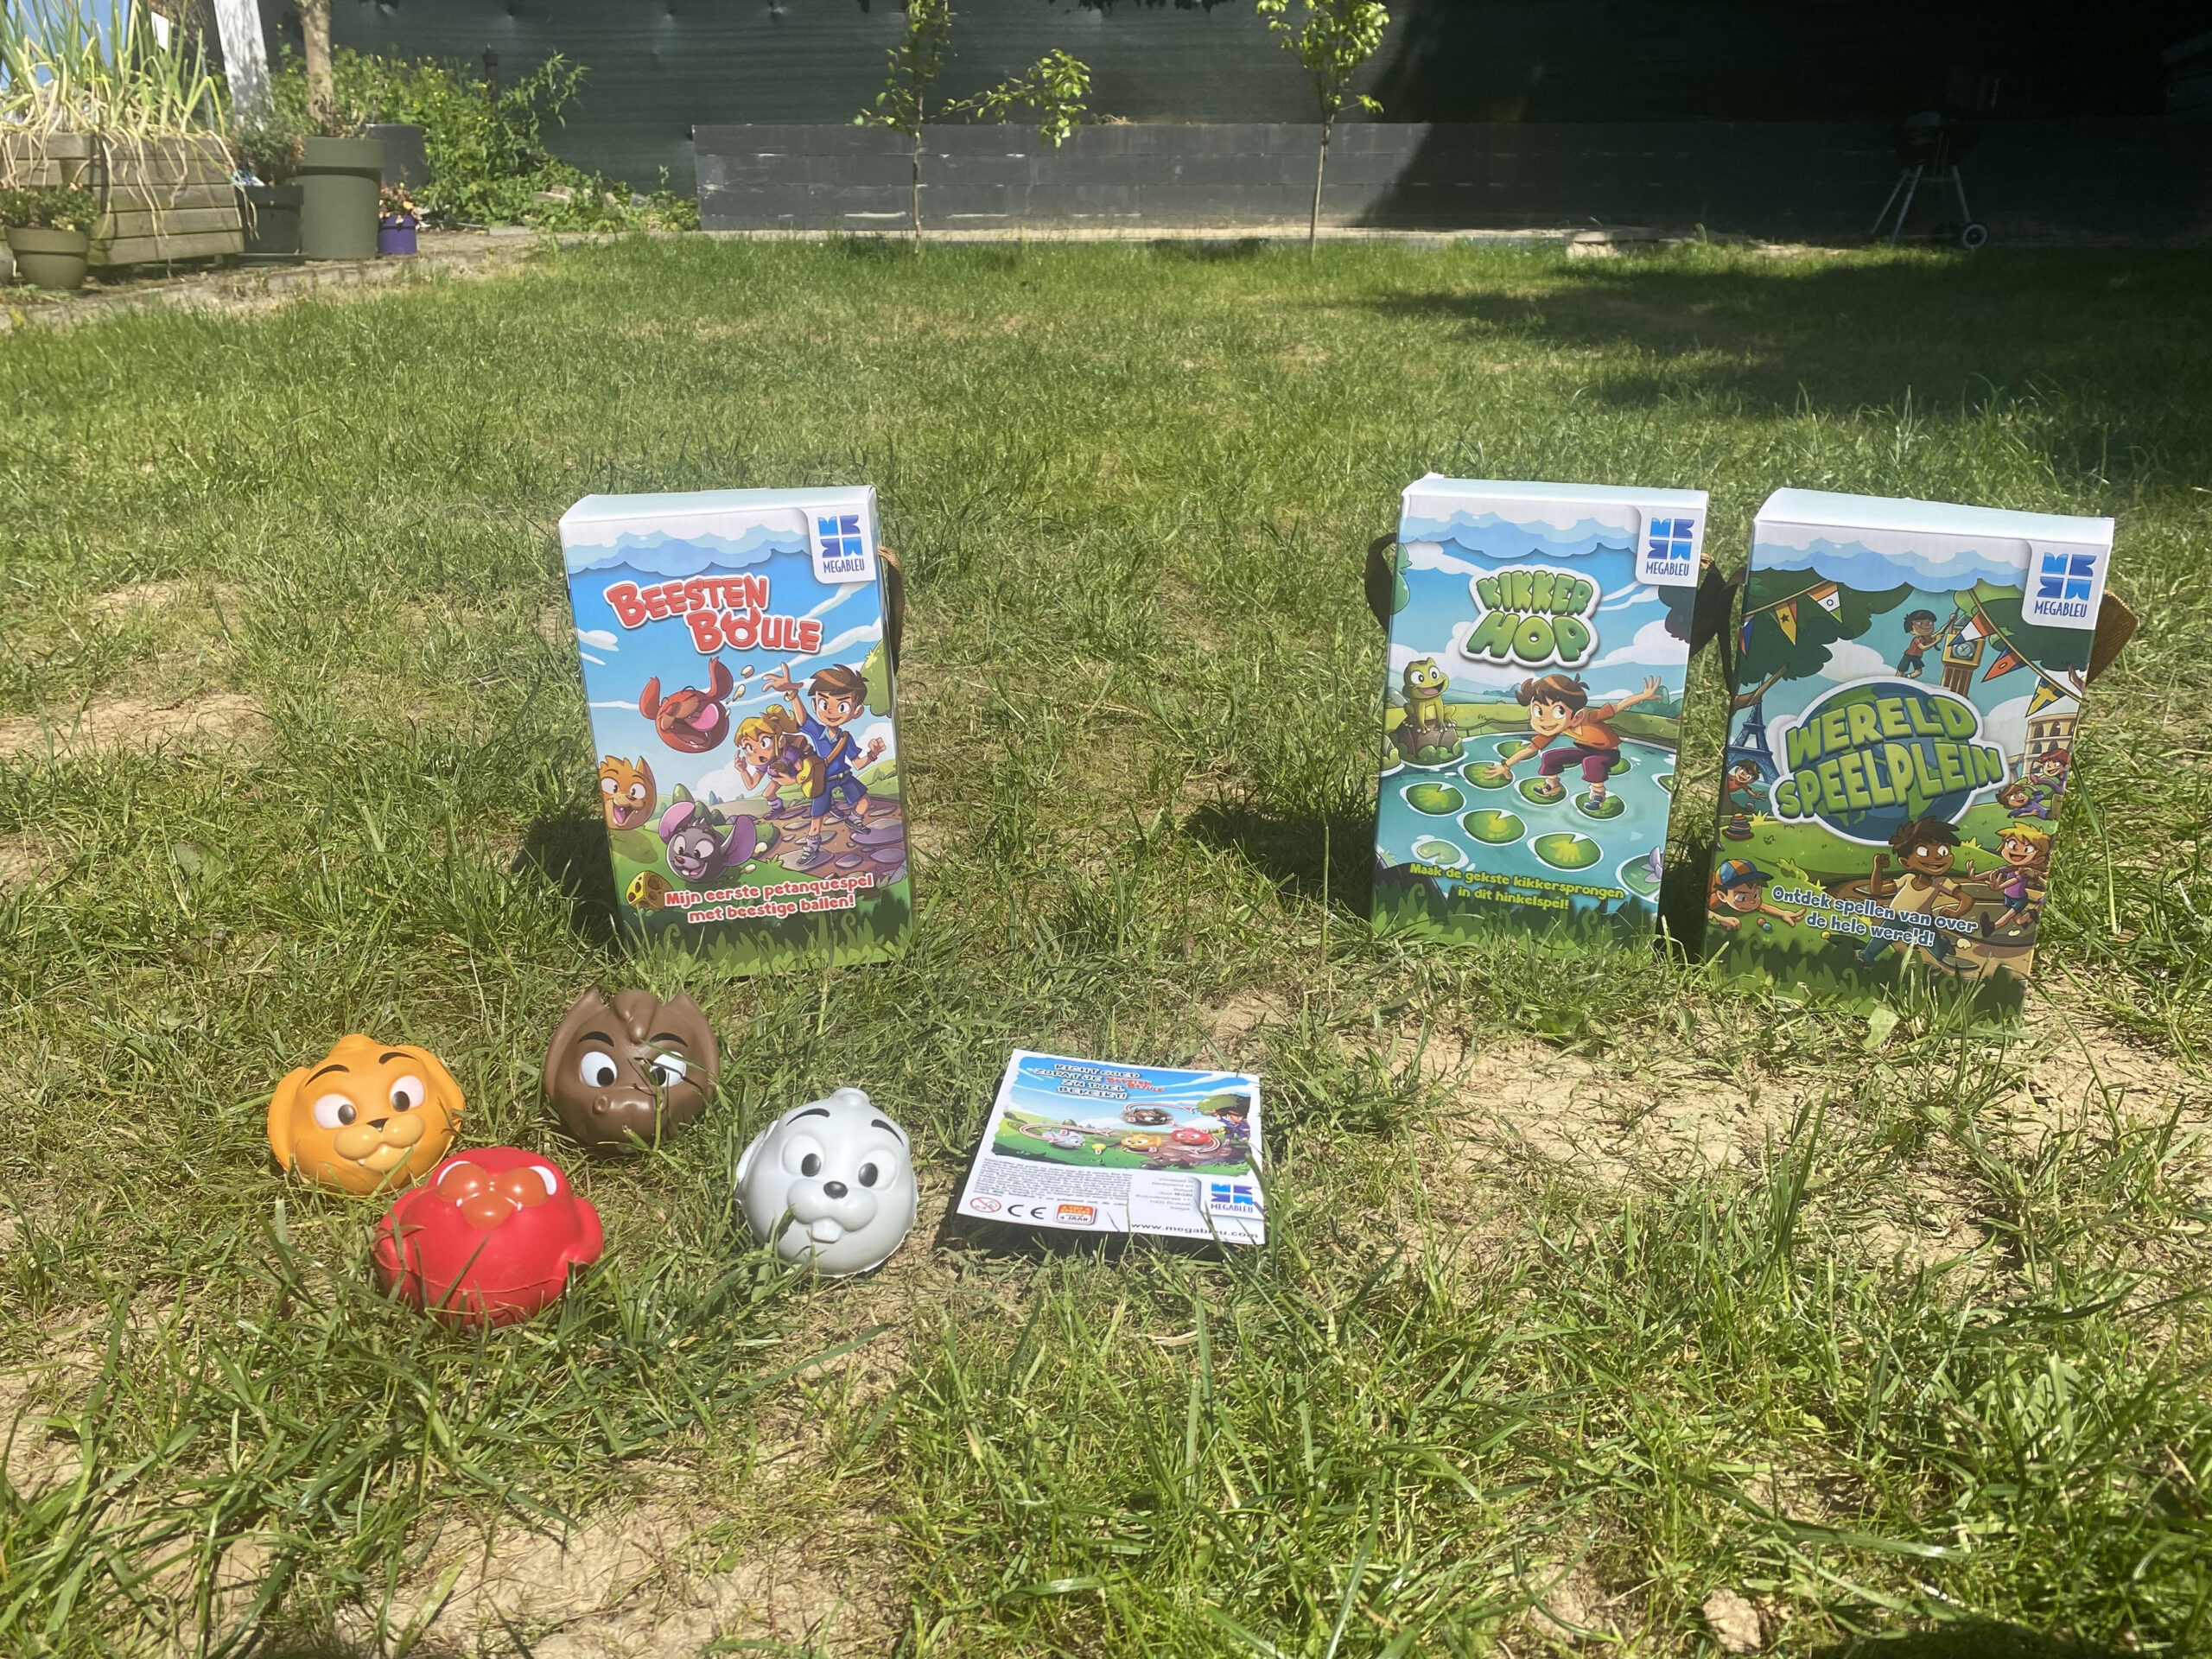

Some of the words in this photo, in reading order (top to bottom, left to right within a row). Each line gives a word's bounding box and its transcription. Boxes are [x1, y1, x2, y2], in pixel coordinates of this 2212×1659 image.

[823, 558, 866, 574] MEGABLEU
[1645, 562, 1691, 576] MEGABLEU
[606, 574, 769, 630] BEESTEN
[1475, 569, 1594, 616] KIKKER
[2033, 600, 2088, 619] MEGABLEU
[686, 607, 823, 653] BOULE
[1466, 609, 1592, 663] HOP
[1785, 694, 1978, 769] WERELD
[1775, 741, 2005, 819] SPEELPLEIN
[664, 890, 702, 907] Mijn
[705, 883, 760, 899] eerste
[764, 875, 874, 900] petanquespel
[1410, 862, 1442, 876] Maak
[1446, 868, 1462, 880] de
[1465, 871, 1510, 886] gekste
[1513, 876, 1625, 900] kikkersprongen
[689, 910, 722, 922] met
[727, 901, 795, 918] beestige
[800, 896, 855, 912] ballen!
[1458, 886, 1471, 898] in
[1474, 888, 1491, 901] dit
[1495, 892, 1569, 910] hinkelspel!
[1771, 885, 1832, 910] Ontdek
[1833, 898, 1895, 920] spellen
[1900, 912, 1933, 925] van
[1936, 916, 1980, 935] over
[1805, 912, 1827, 928] de
[1829, 918, 1866, 935] hele
[1870, 926, 1935, 947] wereld!
[1053, 1064, 1099, 1074] RICHT
[1100, 1070, 1141, 1078] GOED
[1089, 1083, 1125, 1091] DOEL
[1211, 1203, 1254, 1213] MEGABLEU
